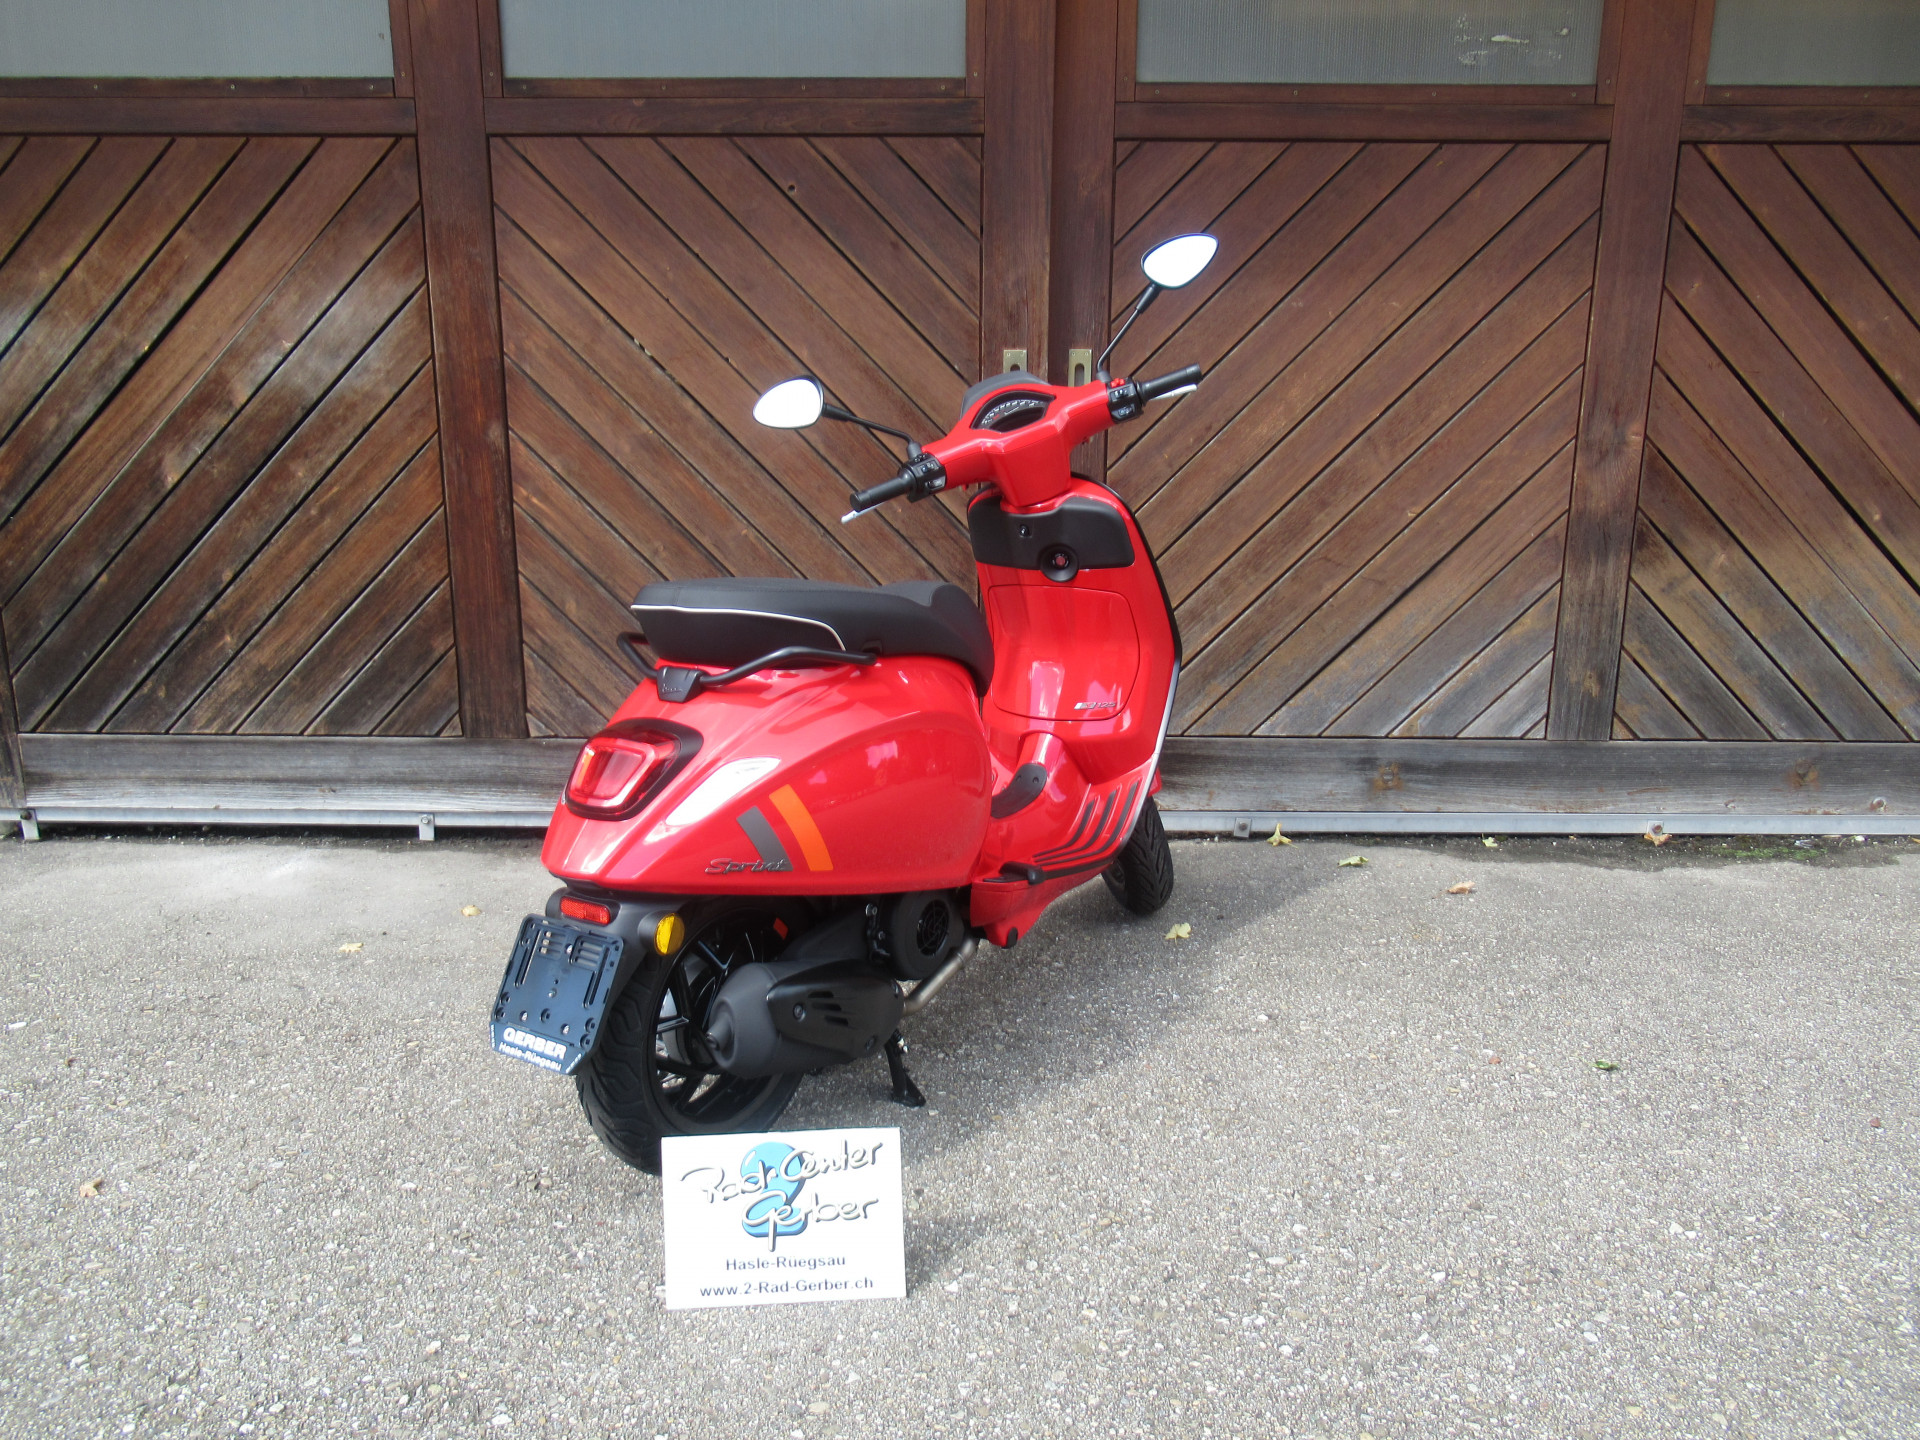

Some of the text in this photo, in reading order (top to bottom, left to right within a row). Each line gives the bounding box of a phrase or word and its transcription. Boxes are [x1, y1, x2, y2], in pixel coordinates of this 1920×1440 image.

[704, 857, 788, 875] Sprint
[503, 1027, 567, 1060] GERBER
[779, 1139, 884, 1182] Center
[741, 1189, 879, 1252] Gerber
[725, 1255, 846, 1271] Hasle-Rüegsau
[699, 1277, 874, 1297] www.2-Rad-Gerber.ch
